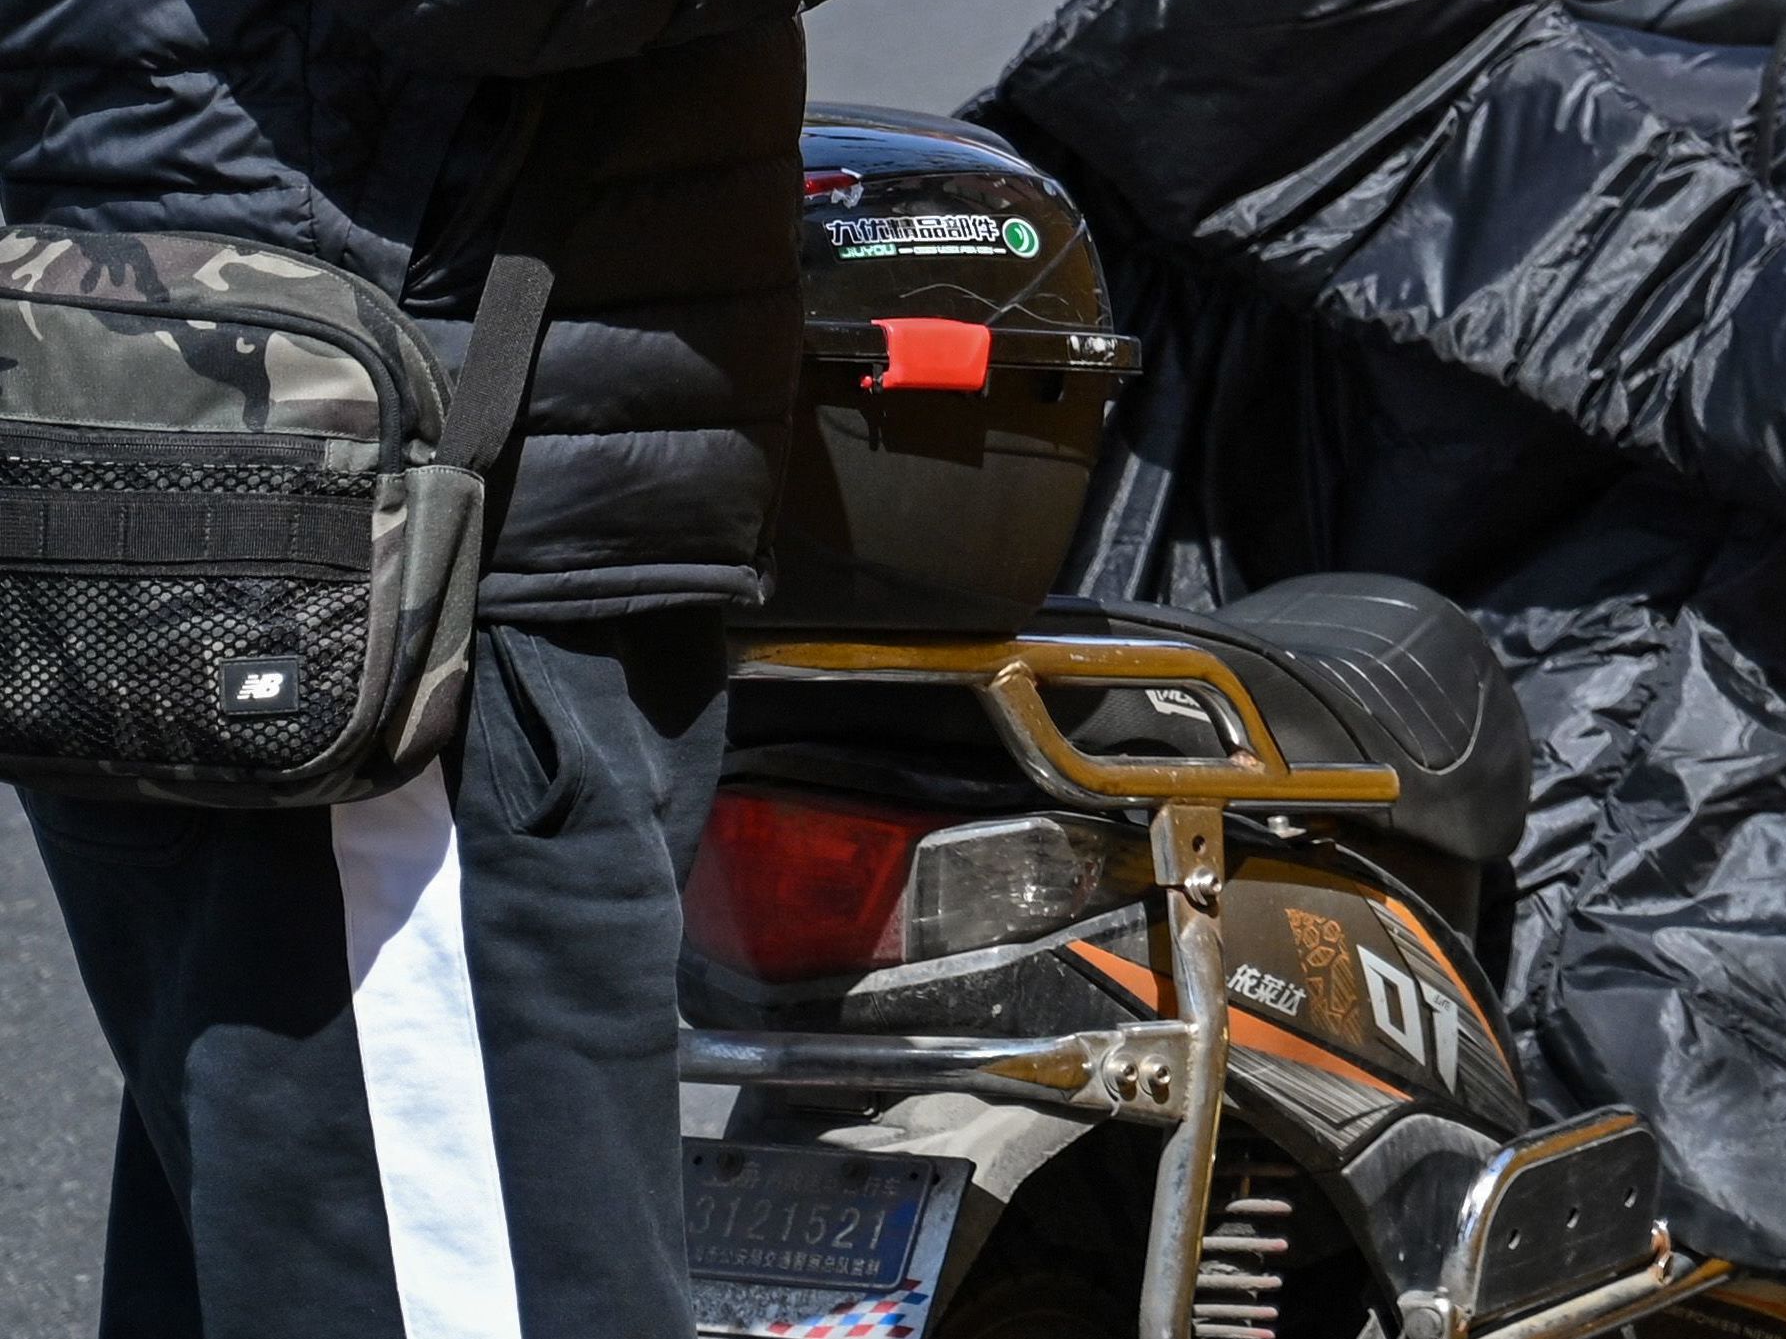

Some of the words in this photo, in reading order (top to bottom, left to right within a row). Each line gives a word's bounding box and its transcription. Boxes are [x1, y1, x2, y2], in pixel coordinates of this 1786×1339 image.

[826, 215, 999, 245] 九优精品部件
[1227, 963, 1307, 1017] 依莱达
